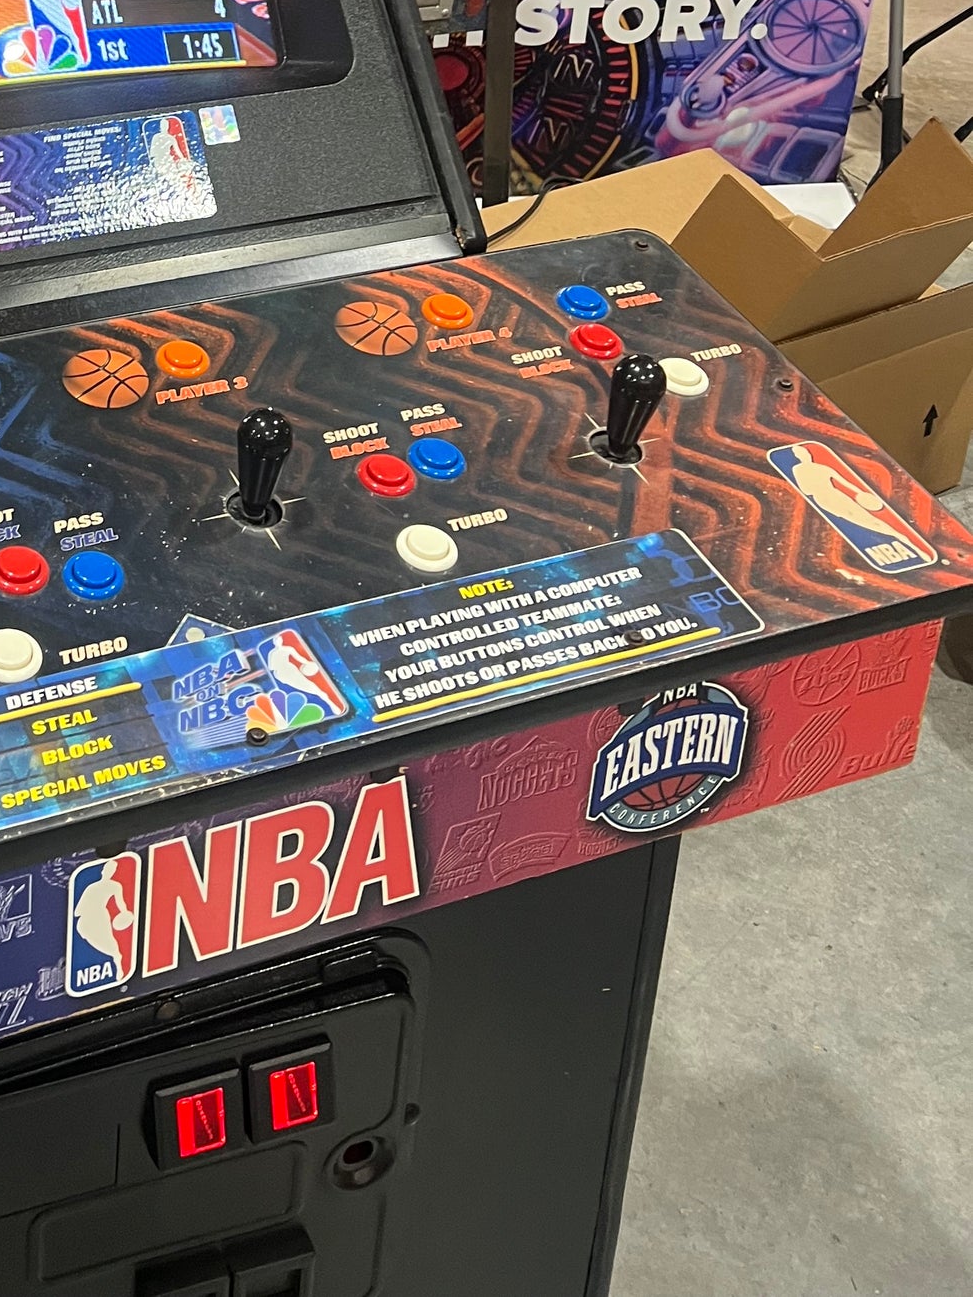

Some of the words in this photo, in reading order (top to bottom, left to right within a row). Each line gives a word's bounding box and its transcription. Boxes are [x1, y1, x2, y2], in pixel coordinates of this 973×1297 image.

[97, 37, 129, 62] 1st
[183, 33, 224, 59] 1:45
[606, 281, 646, 297] PASS
[616, 291, 663, 309] STEAL
[427, 330, 495, 353] PLAYER
[497, 327, 512, 340] 4
[691, 343, 743, 363] TURBO
[511, 345, 563, 366] SHOOT
[519, 359, 574, 379] BLOCK
[154, 380, 229, 406] PLAYER
[232, 376, 248, 392] 3
[401, 403, 446, 422] PASS
[323, 422, 380, 445] SHOOT
[411, 416, 463, 438] STEAL
[330, 436, 390, 460] BLOCK
[54, 512, 105, 534] PASS
[446, 508, 509, 533] TURBO
[60, 528, 119, 552] STEAL
[865, 540, 918, 567] NBA
[459, 578, 515, 600] NOTE:
[348, 622, 407, 649] WHEN
[407, 603, 486, 633] PLAYING
[486, 590, 534, 614] WITH
[533, 586, 548, 605] A
[545, 566, 643, 600] COMPUTER
[399, 614, 520, 658] CONTROLLED
[520, 593, 623, 628] TEAMMATE:
[58, 636, 128, 666] TURBO
[384, 657, 439, 684] YOUR
[439, 639, 525, 672] BUTTONS
[525, 619, 610, 650] CONTROL
[609, 603, 663, 628] WHEN
[172, 650, 247, 702] NBA
[374, 690, 404, 709] HE
[401, 669, 480, 703] SHOOTS
[478, 663, 509, 682] OR
[506, 644, 580, 675] PASSES
[579, 632, 630, 660] BACK
[652, 616, 699, 638] YOU.
[6, 675, 99, 712] DEFENSE
[194, 684, 221, 701] ON
[31, 708, 98, 737] STEAL
[179, 687, 262, 734] NBC
[41, 734, 114, 767] BLOCK
[600, 712, 739, 802] EASTERN
[1, 772, 93, 810] SPECIAL
[93, 754, 167, 788] MOVES
[609, 774, 718, 825] CONFERENCE
[144, 775, 421, 979] NBA
[76, 961, 114, 988] NBA
